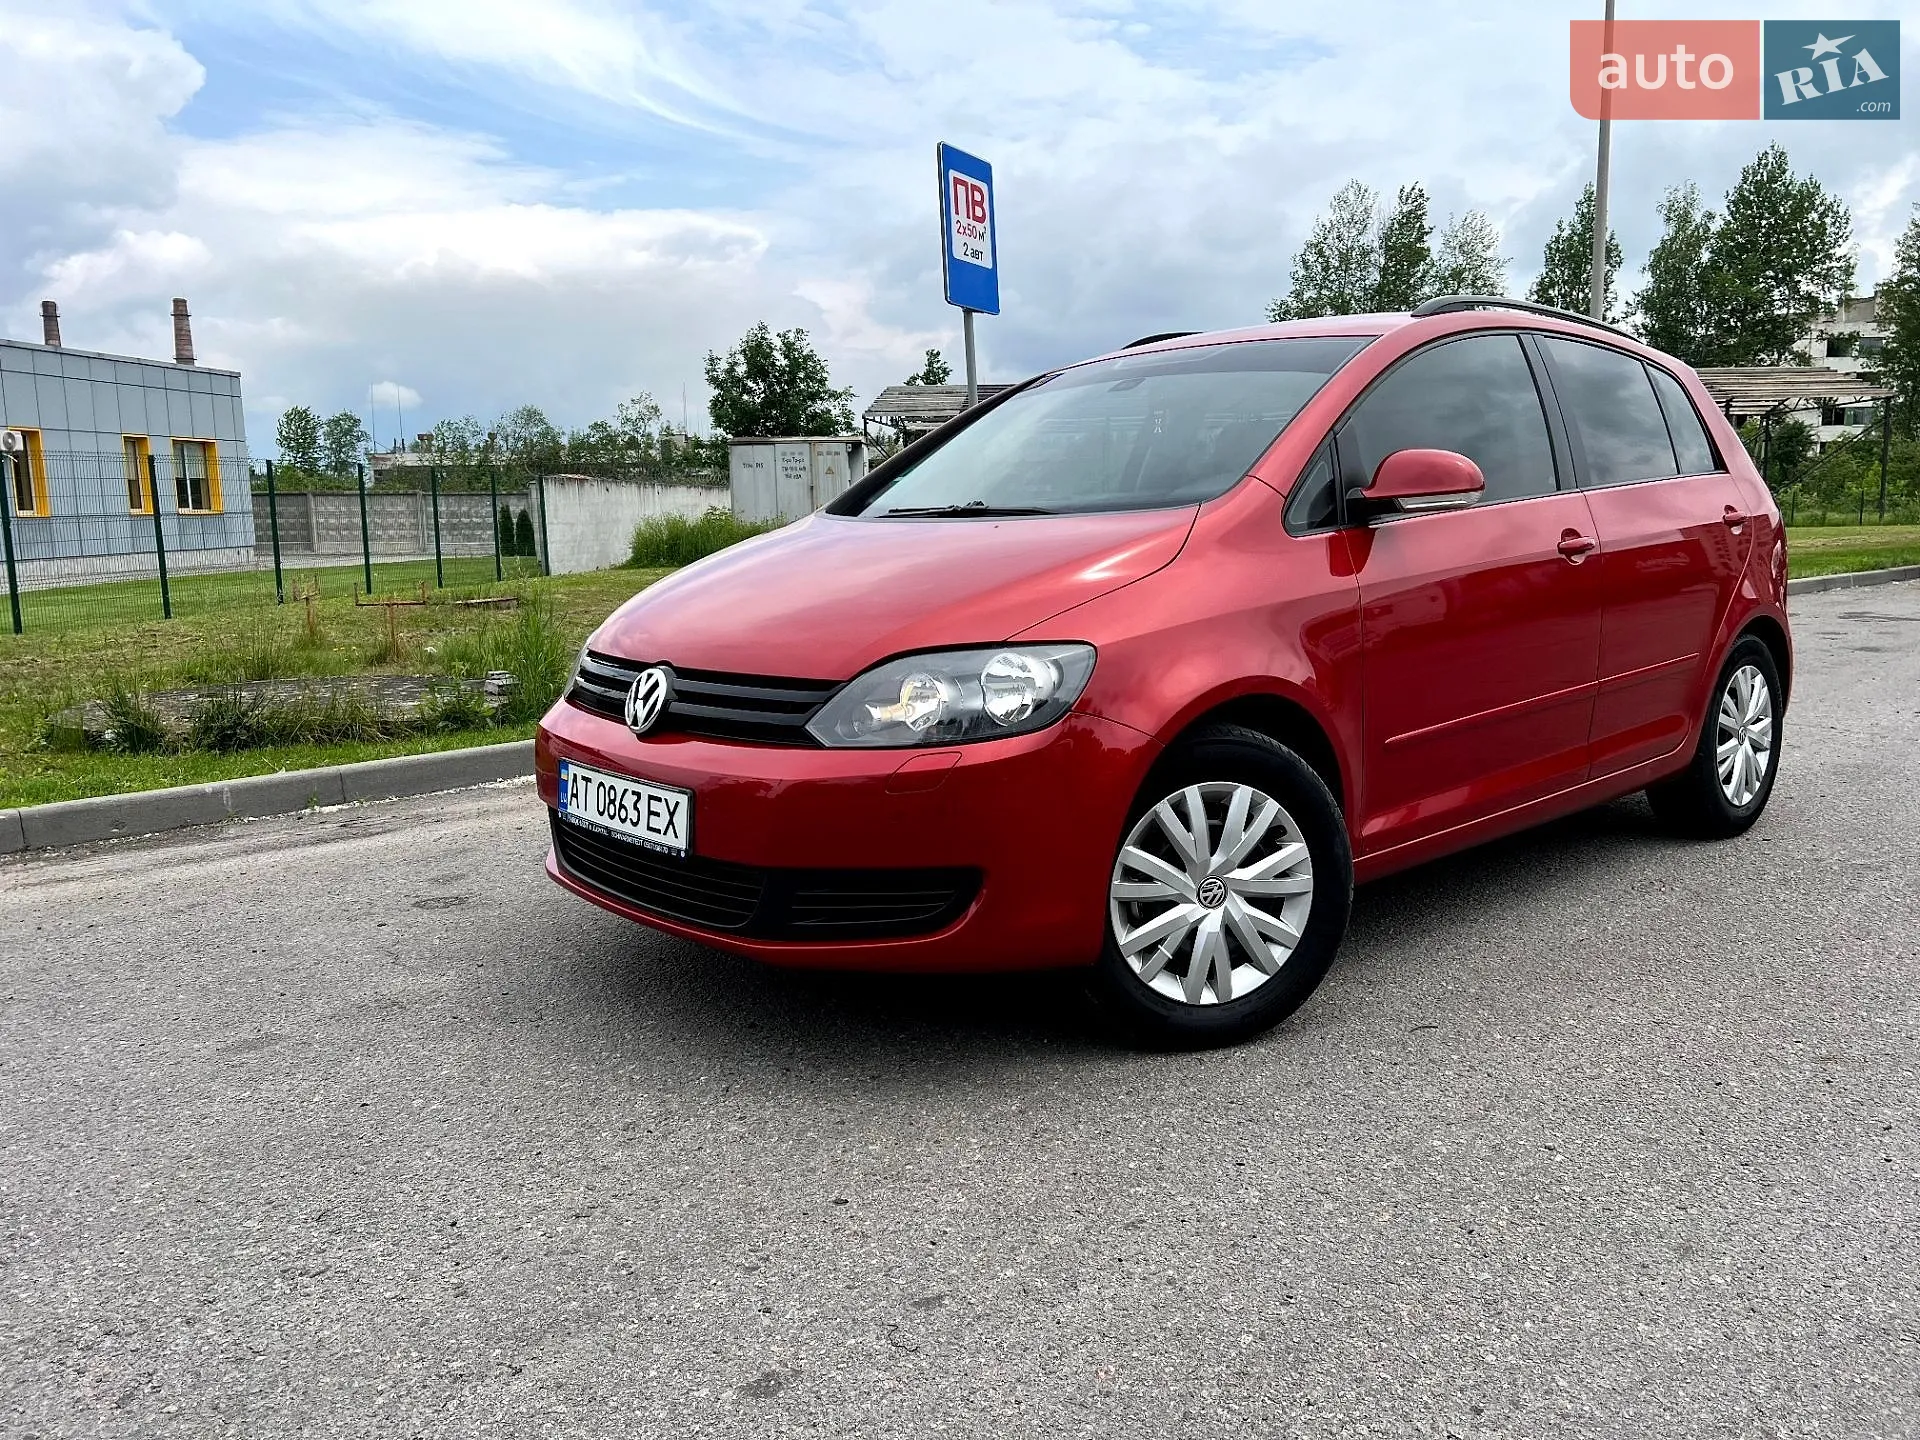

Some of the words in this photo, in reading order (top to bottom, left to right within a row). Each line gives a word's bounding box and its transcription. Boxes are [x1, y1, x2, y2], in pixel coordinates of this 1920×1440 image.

[953, 176, 987, 224] ПВ
[963, 242, 969, 257] 2
[569, 772, 592, 812] AT
[596, 781, 642, 828] 0863
[646, 793, 681, 839] EX
